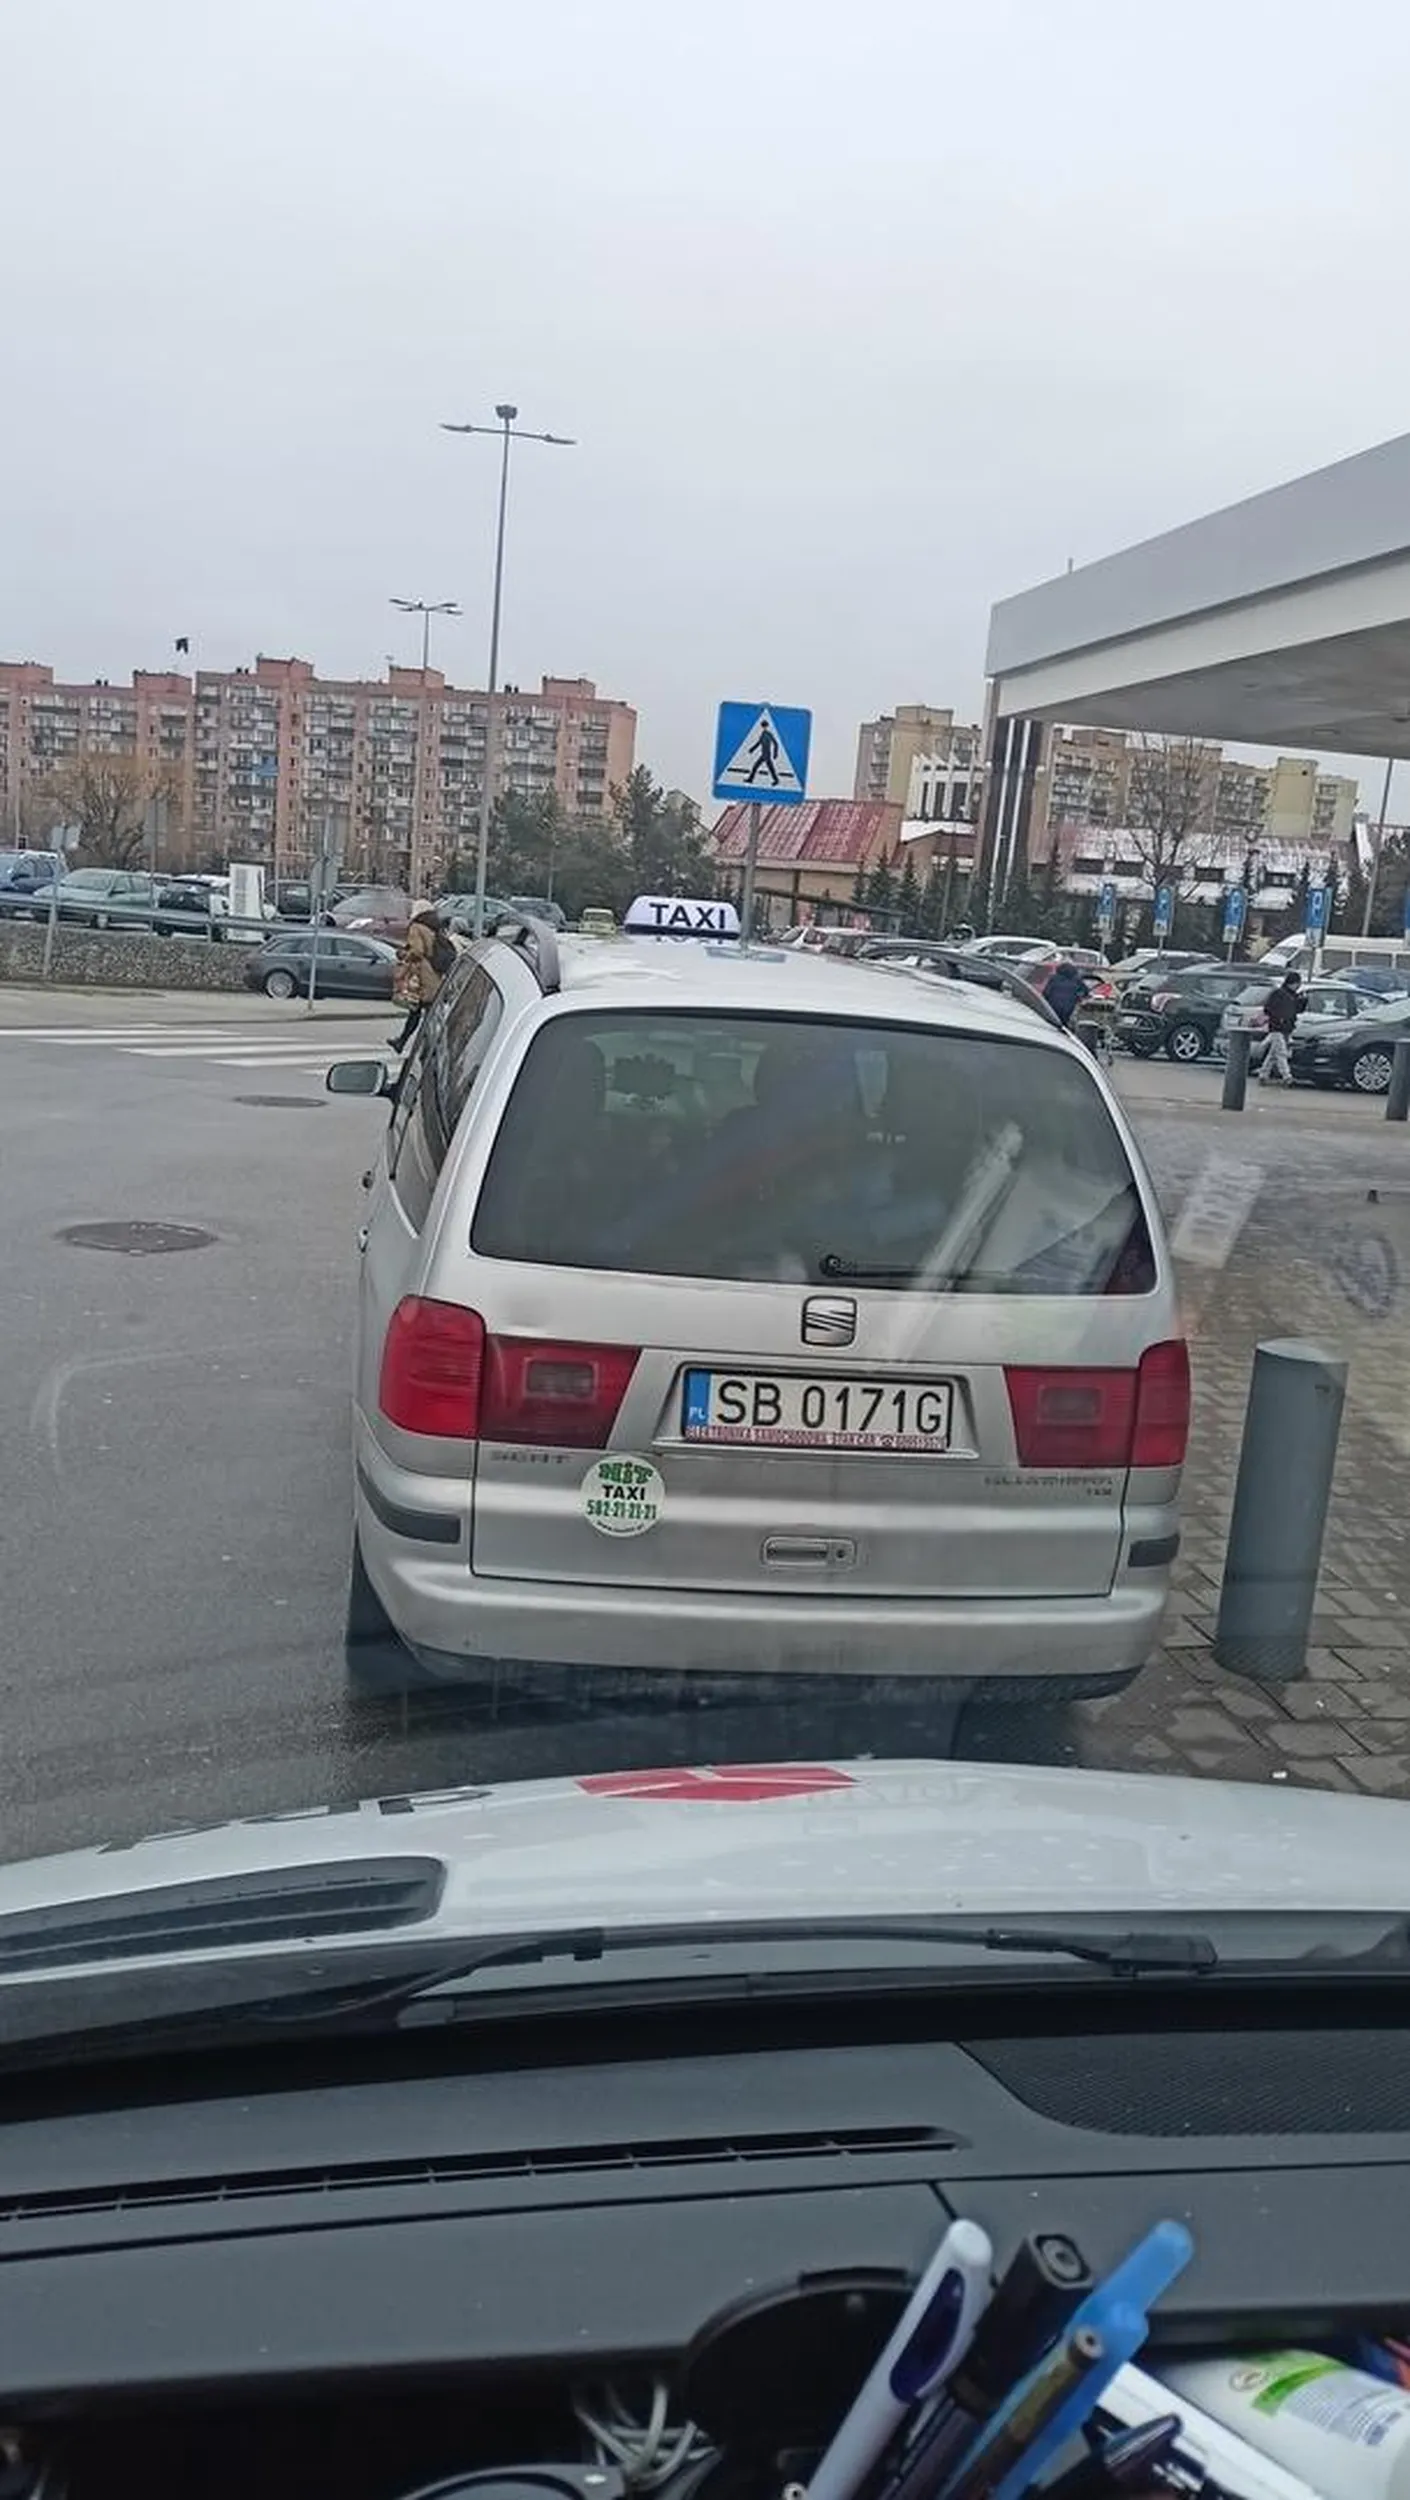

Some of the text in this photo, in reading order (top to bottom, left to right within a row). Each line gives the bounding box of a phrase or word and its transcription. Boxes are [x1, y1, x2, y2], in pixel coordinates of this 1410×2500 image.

[649, 903, 726, 929] TAXI
[688, 1407, 707, 1420] PL
[717, 1379, 941, 1433] SB 0171G
[602, 1484, 646, 1500] TAXI
